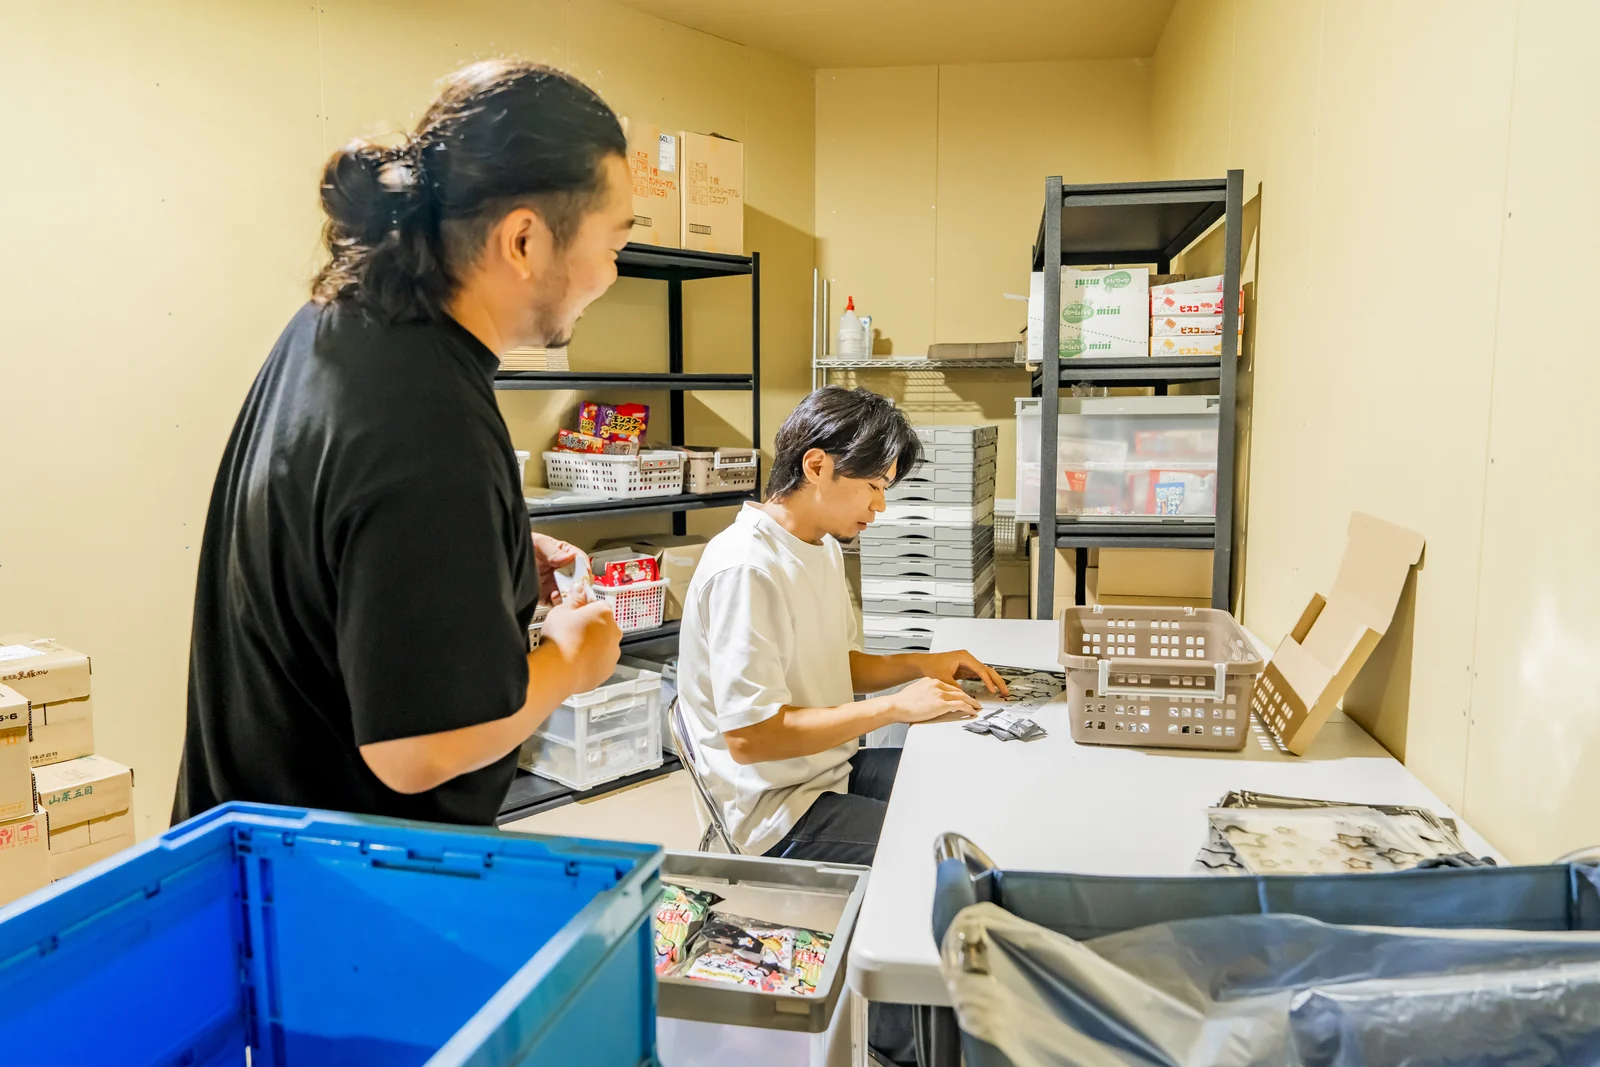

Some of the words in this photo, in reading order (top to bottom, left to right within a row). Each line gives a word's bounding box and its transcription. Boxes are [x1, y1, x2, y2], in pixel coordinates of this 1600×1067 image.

[1096, 305, 1121, 315] mini
[1180, 305, 1199, 313] ビスコ
[1089, 341, 1111, 350] mini
